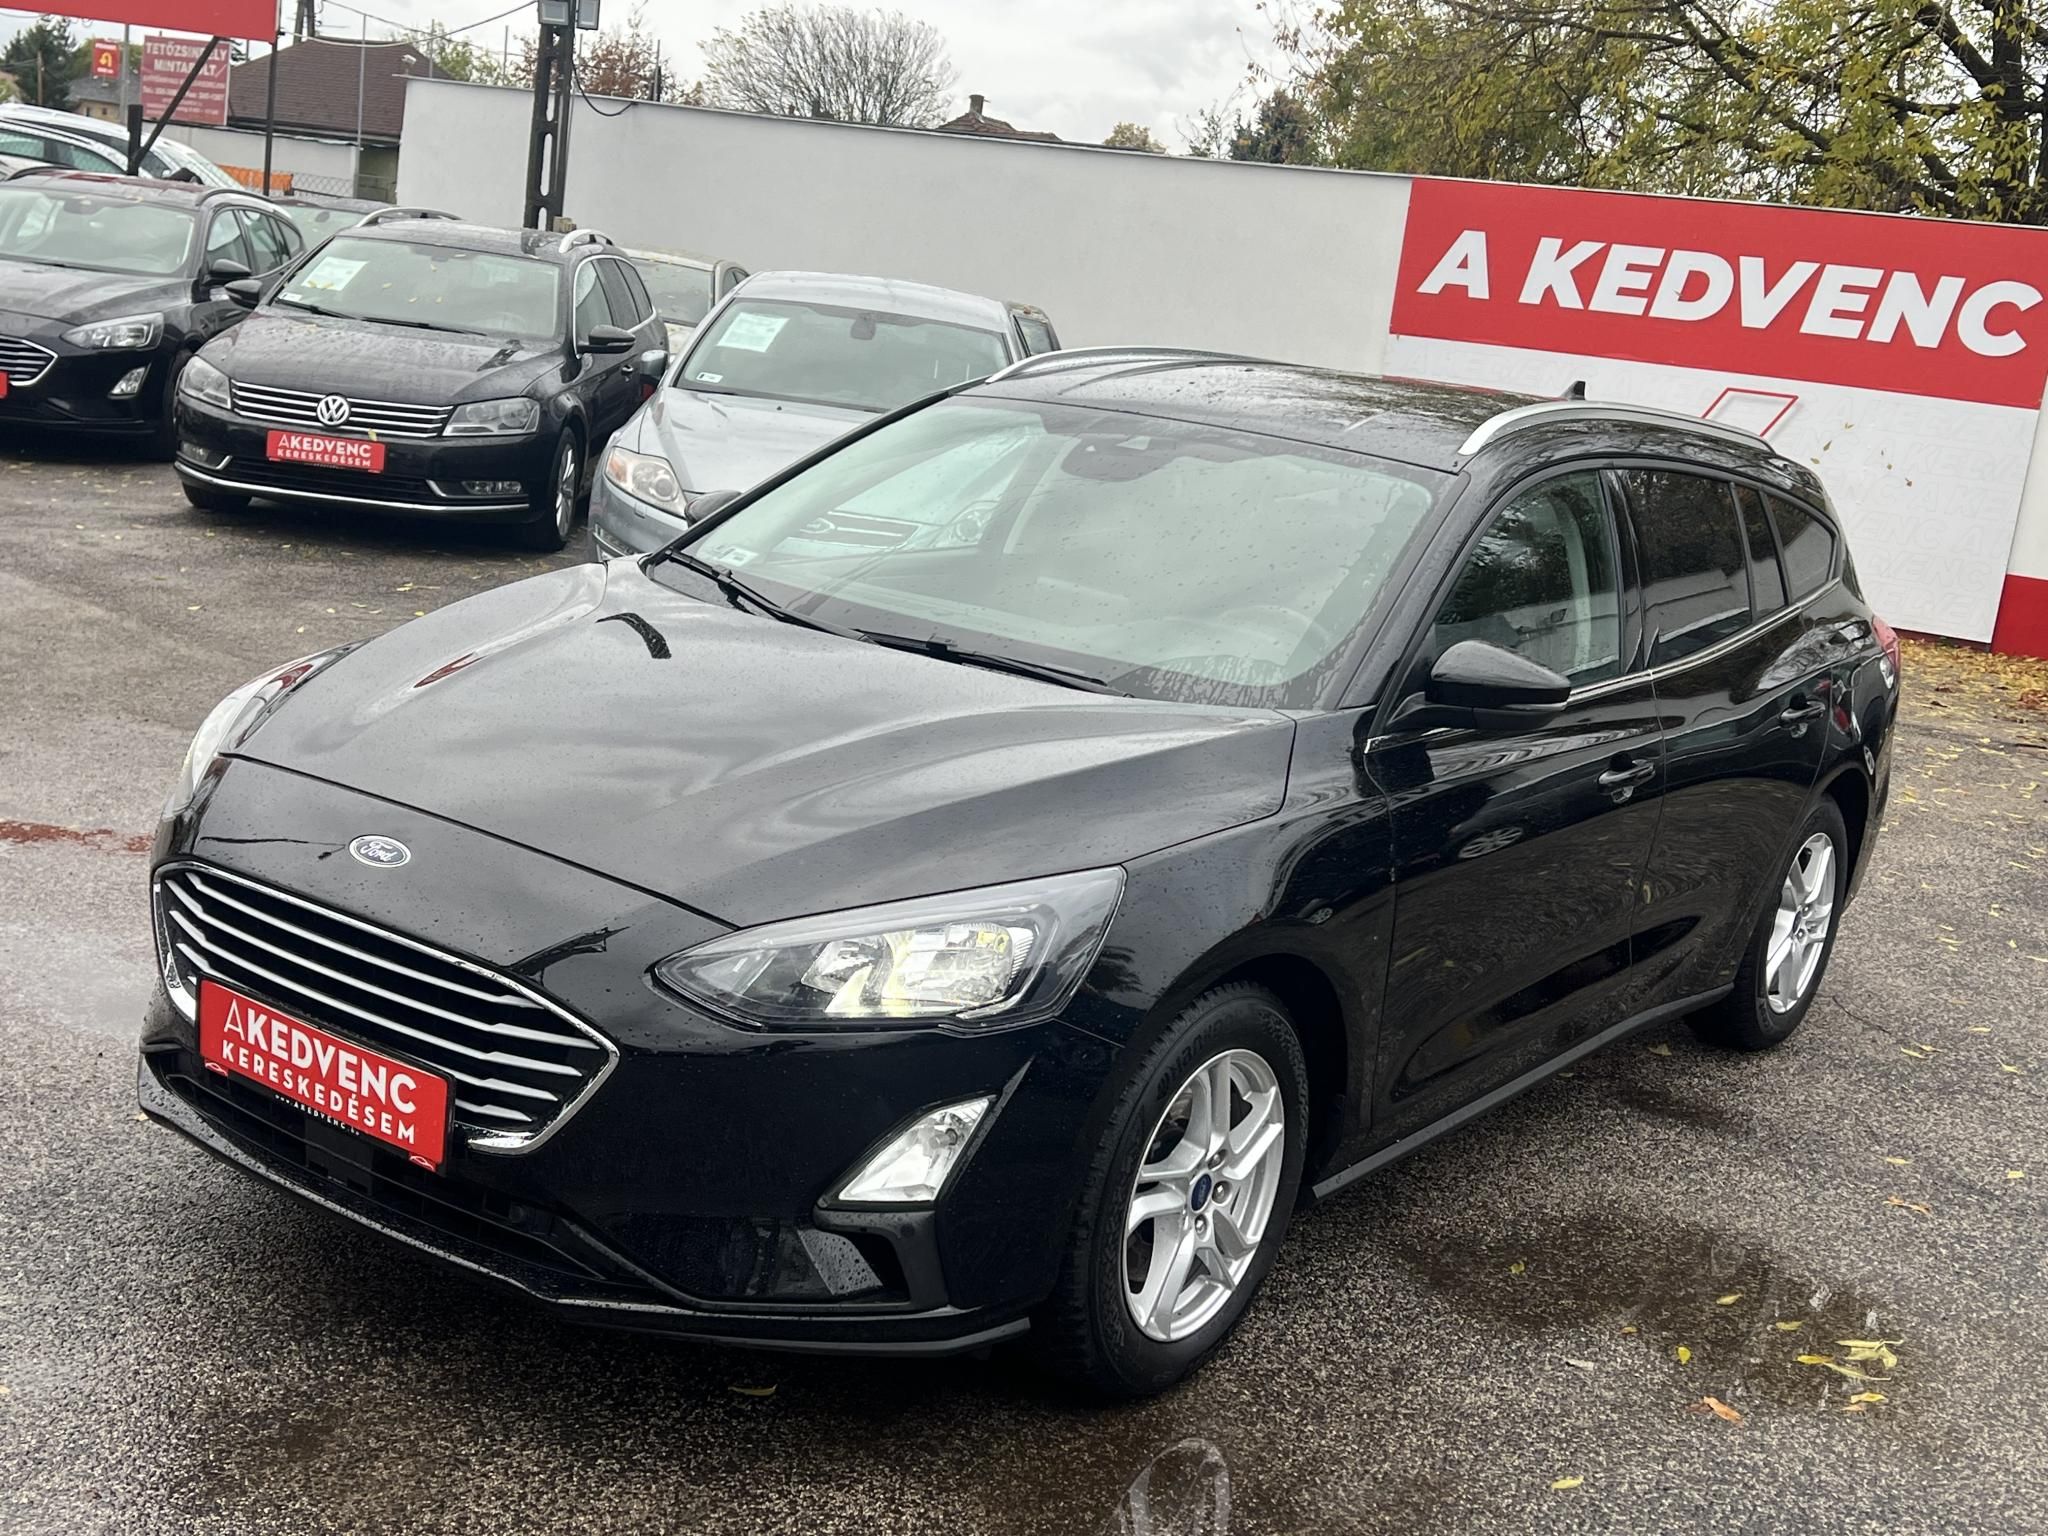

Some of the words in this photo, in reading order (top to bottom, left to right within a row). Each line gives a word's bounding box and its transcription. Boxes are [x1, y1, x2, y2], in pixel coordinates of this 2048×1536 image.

[154, 59, 217, 76] MINTABLT
[1416, 229, 1490, 300] A
[1518, 236, 2044, 358] KEDVENC
[277, 448, 371, 467] KERESKEDÉSEM
[221, 1040, 416, 1145] KERESKEDÉSEM
